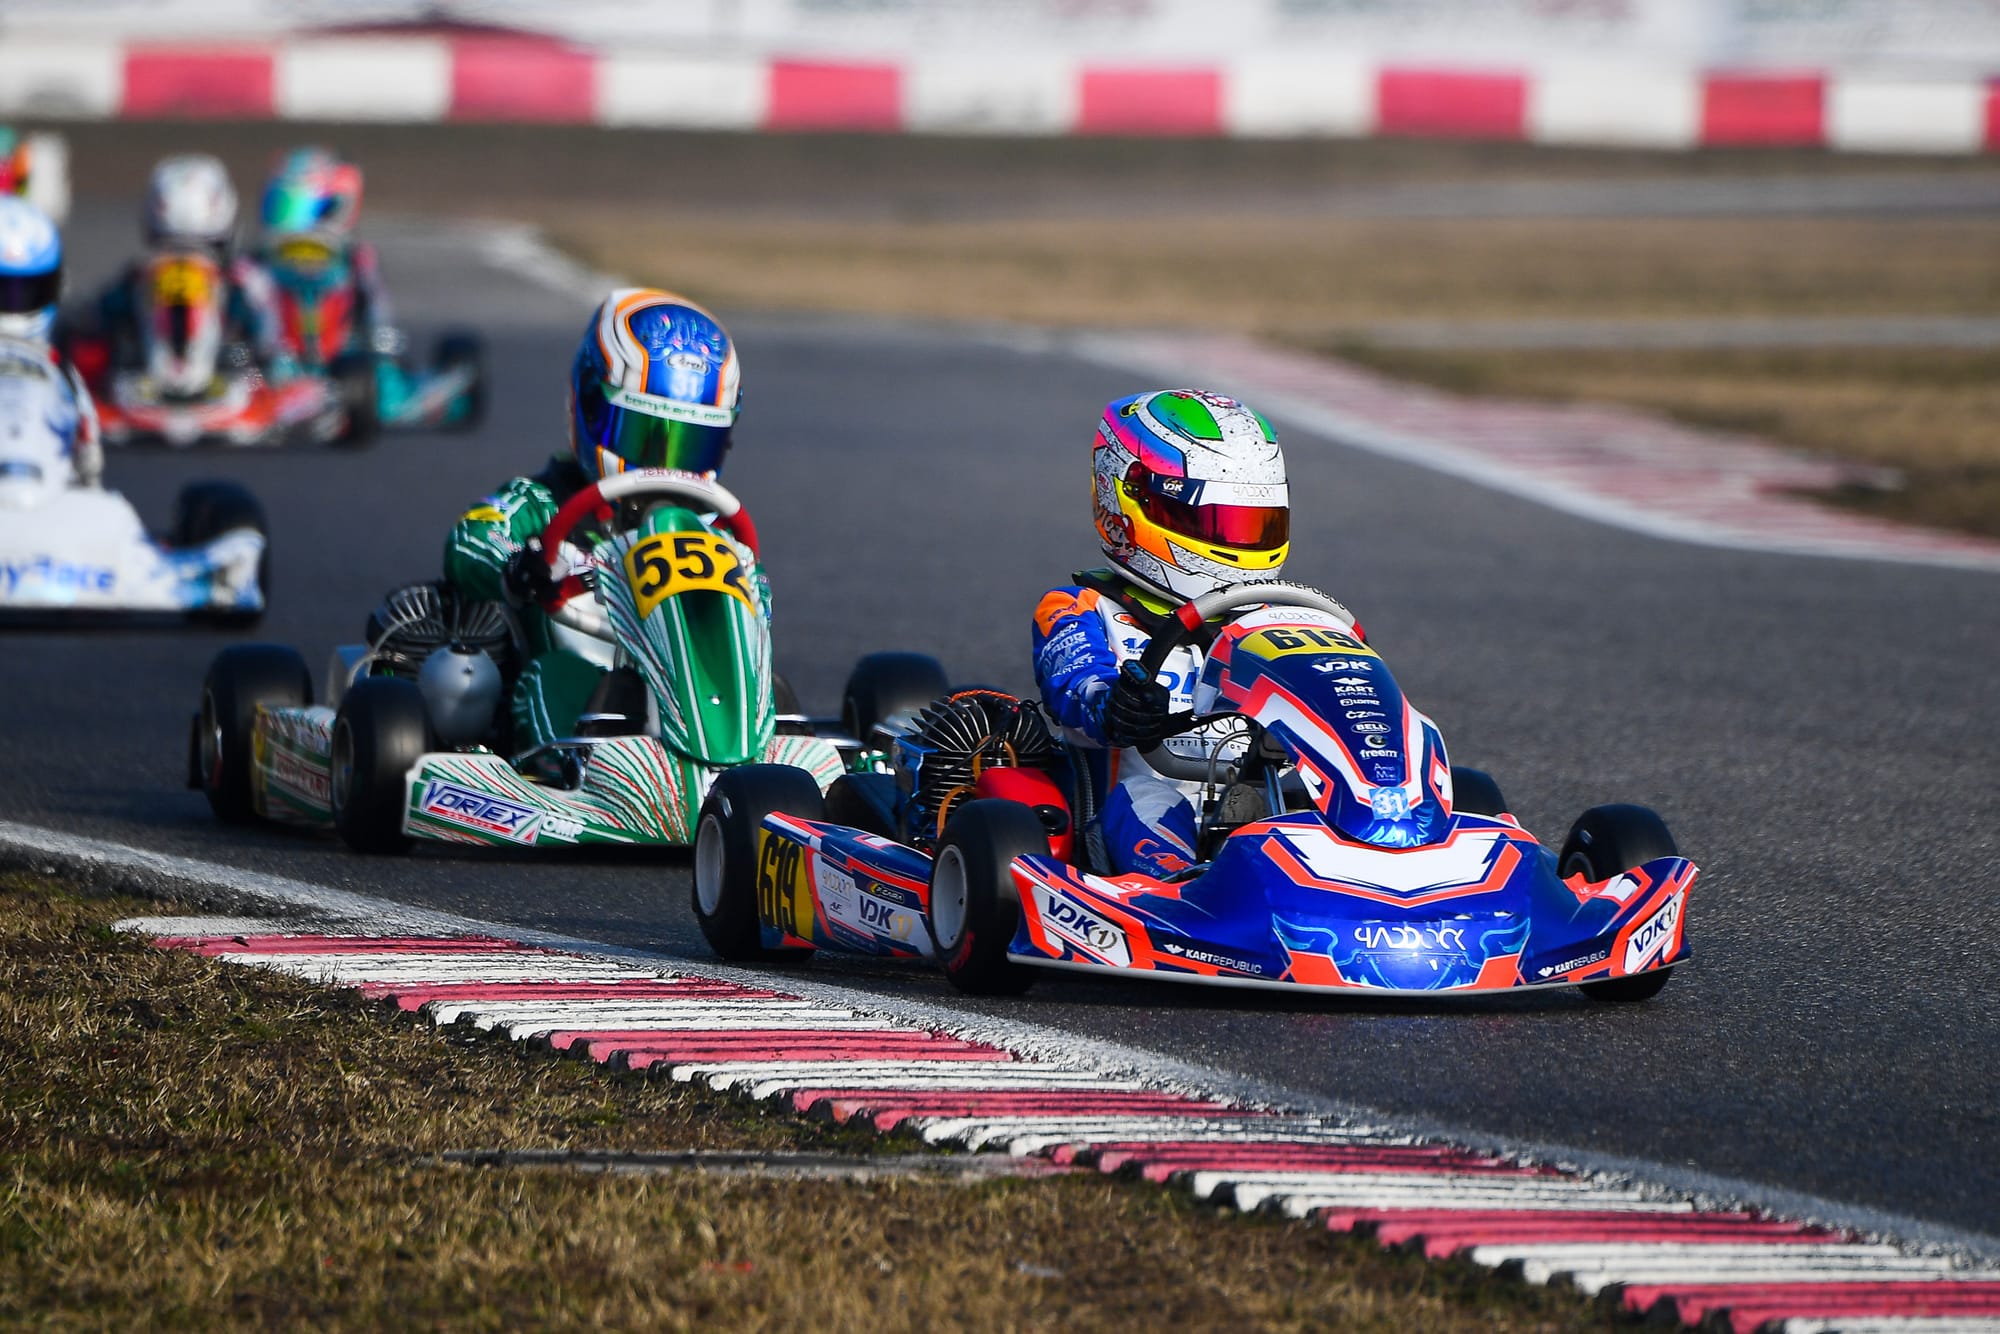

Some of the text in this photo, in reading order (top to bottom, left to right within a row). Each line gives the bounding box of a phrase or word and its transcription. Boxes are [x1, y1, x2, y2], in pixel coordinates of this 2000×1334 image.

[1162, 482, 1184, 492] VDK
[632, 537, 752, 598] 552
[1260, 629, 1366, 650] 619
[1312, 661, 1373, 673] VDK
[1360, 750, 1398, 760] freem
[426, 782, 534, 827] VORTEX
[542, 816, 585, 837] OMP
[758, 833, 800, 937] 619
[860, 895, 896, 930] VDK
[1048, 896, 1099, 937] VDK
[1633, 912, 1668, 953] VDK
[1185, 949, 1262, 974] KARTREPUBLIC
[1554, 950, 1606, 974] KARTREPUBLIC
